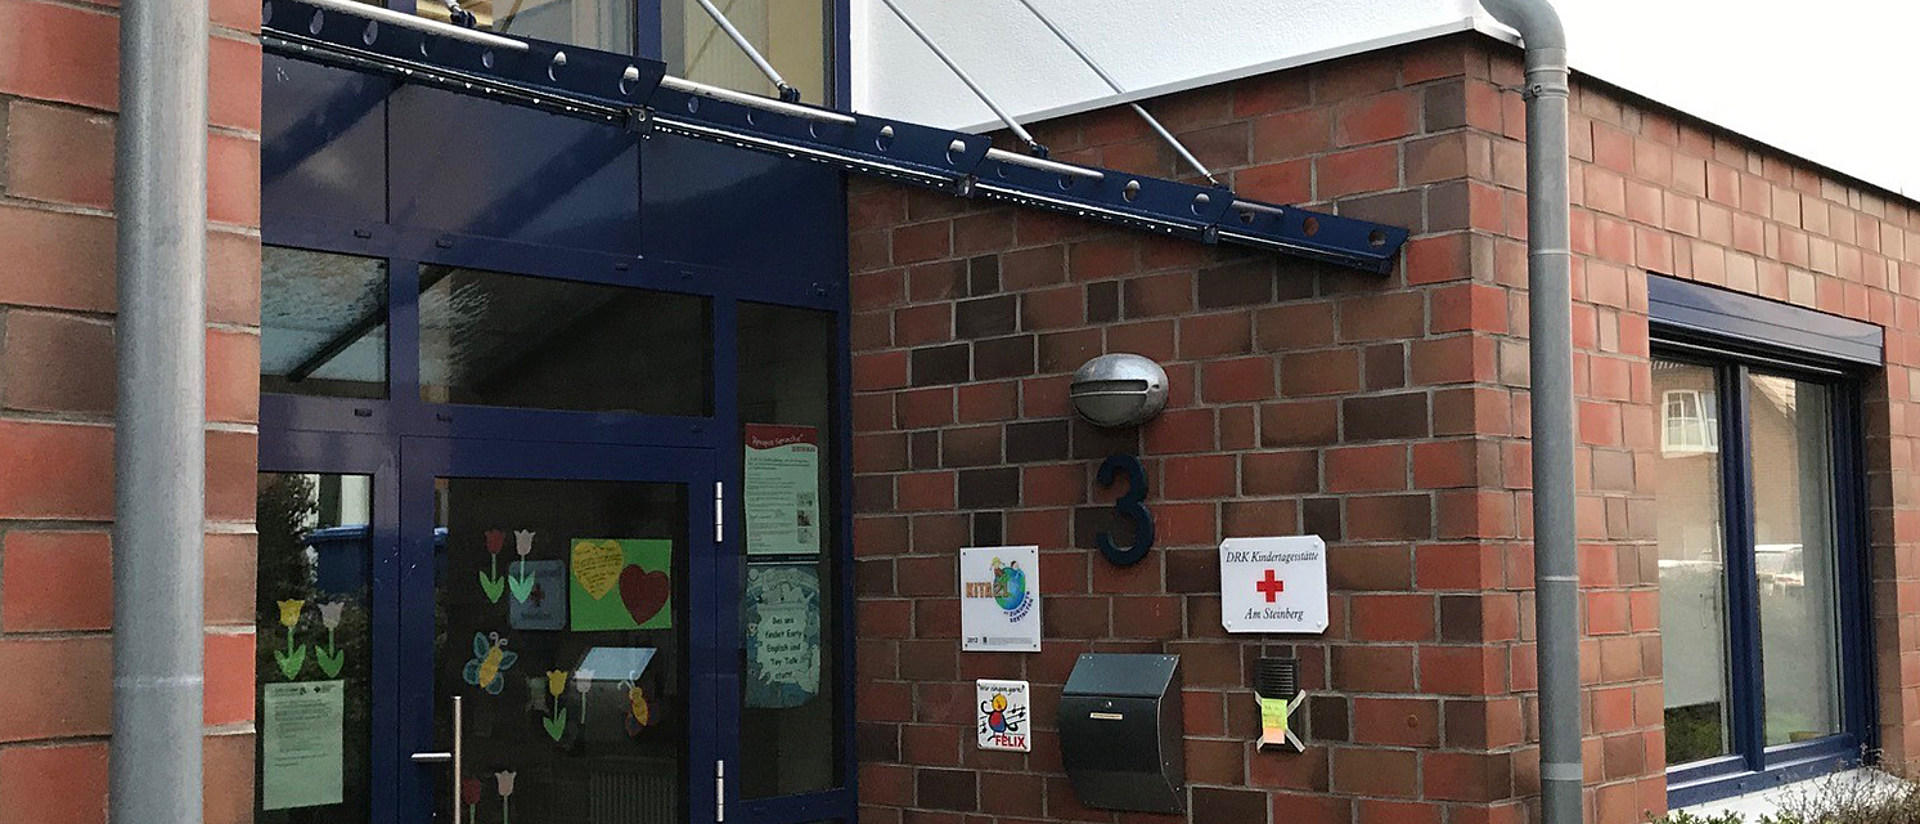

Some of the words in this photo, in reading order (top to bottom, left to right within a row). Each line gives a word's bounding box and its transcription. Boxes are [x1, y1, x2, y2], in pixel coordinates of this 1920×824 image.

[1096, 453, 1155, 565] 3
[1226, 551, 1250, 563] DRK
[1251, 551, 1319, 564] Kindertagesstätte
[1244, 608, 1261, 620] Am
[1263, 607, 1304, 622] Steinberg
[765, 630, 785, 639] findet
[786, 629, 802, 639] Early
[766, 644, 789, 654] English
[995, 734, 1026, 747] FELIX
